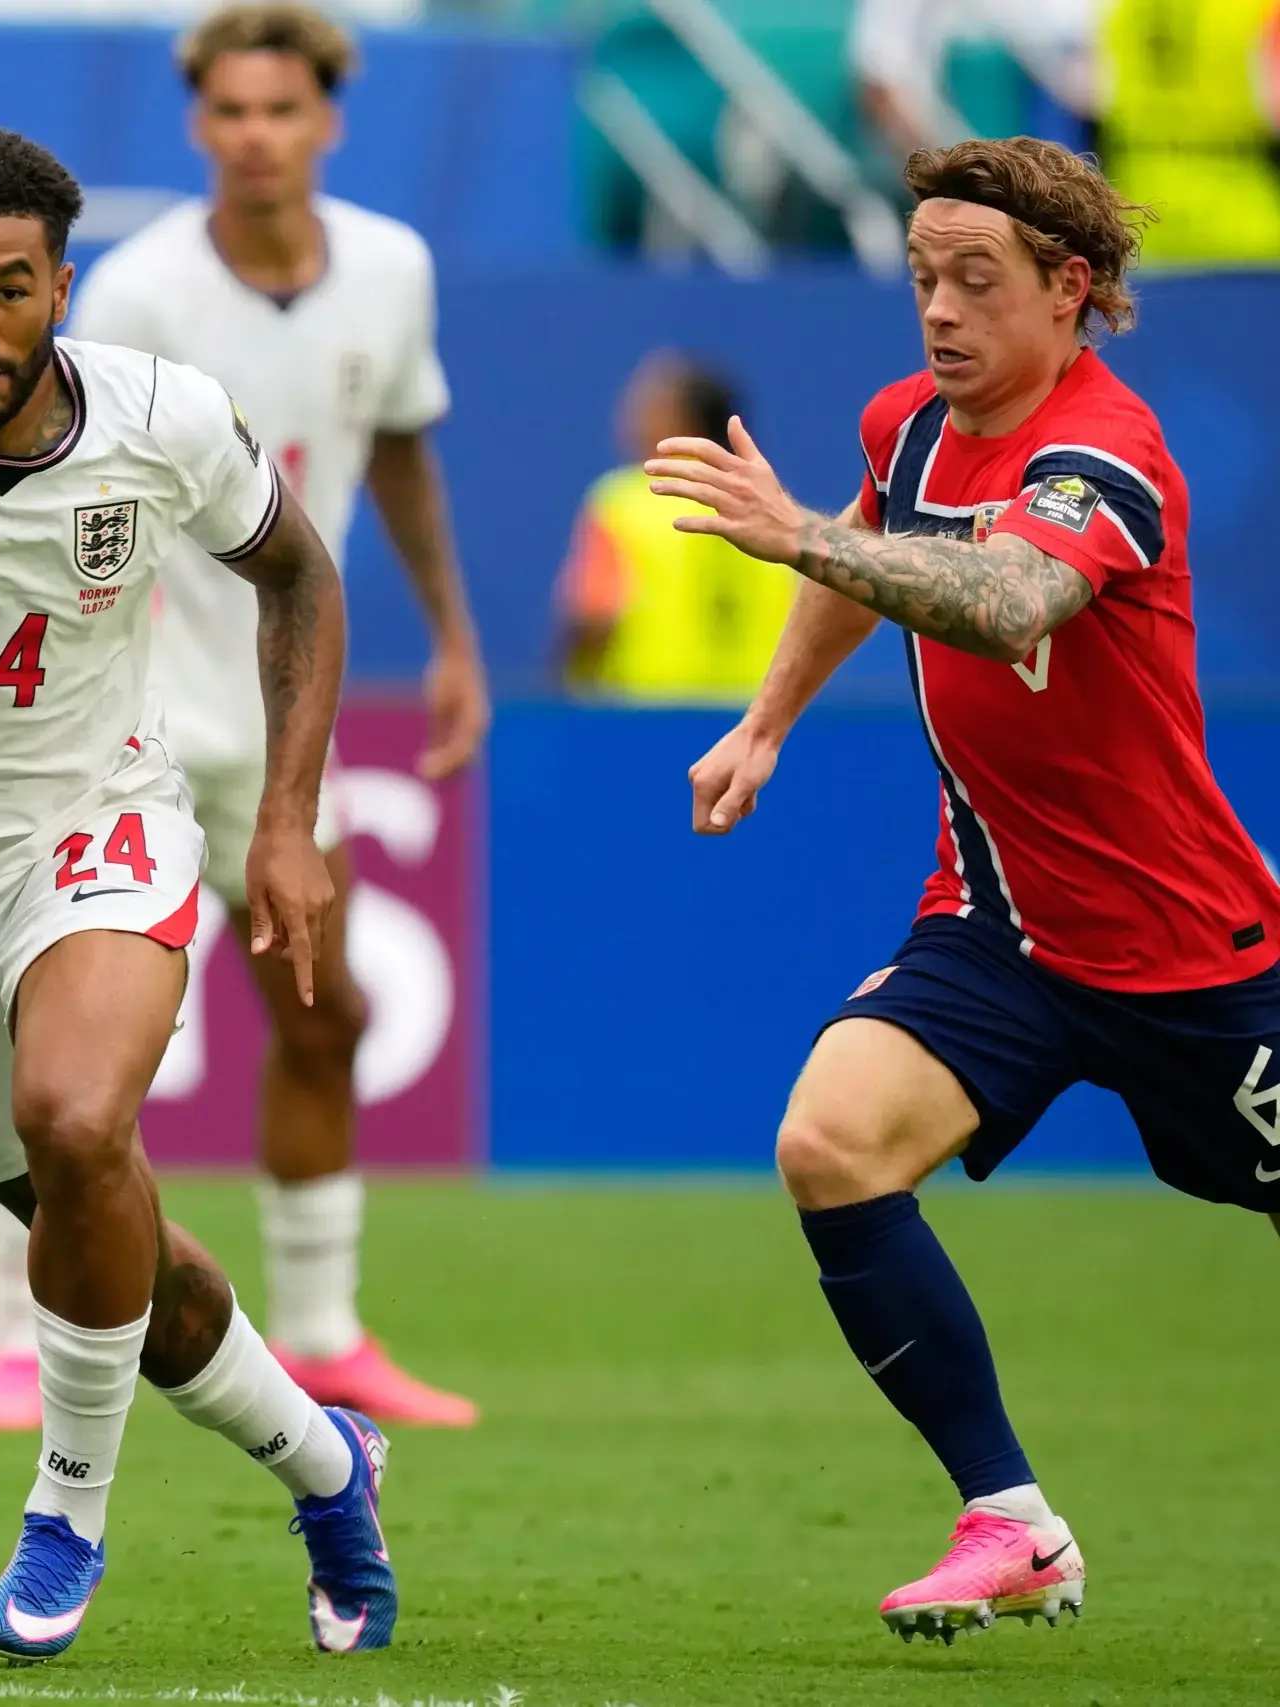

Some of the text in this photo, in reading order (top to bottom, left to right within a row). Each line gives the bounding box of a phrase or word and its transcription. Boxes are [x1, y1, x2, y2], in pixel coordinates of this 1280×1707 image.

[1037, 497, 1082, 521] EDUCATION
[1046, 510, 1065, 521] FIFA
[79, 584, 124, 601] NORWAY
[53, 812, 157, 891] 24
[247, 1431, 289, 1460] ENG
[47, 1450, 91, 1480] ENG
